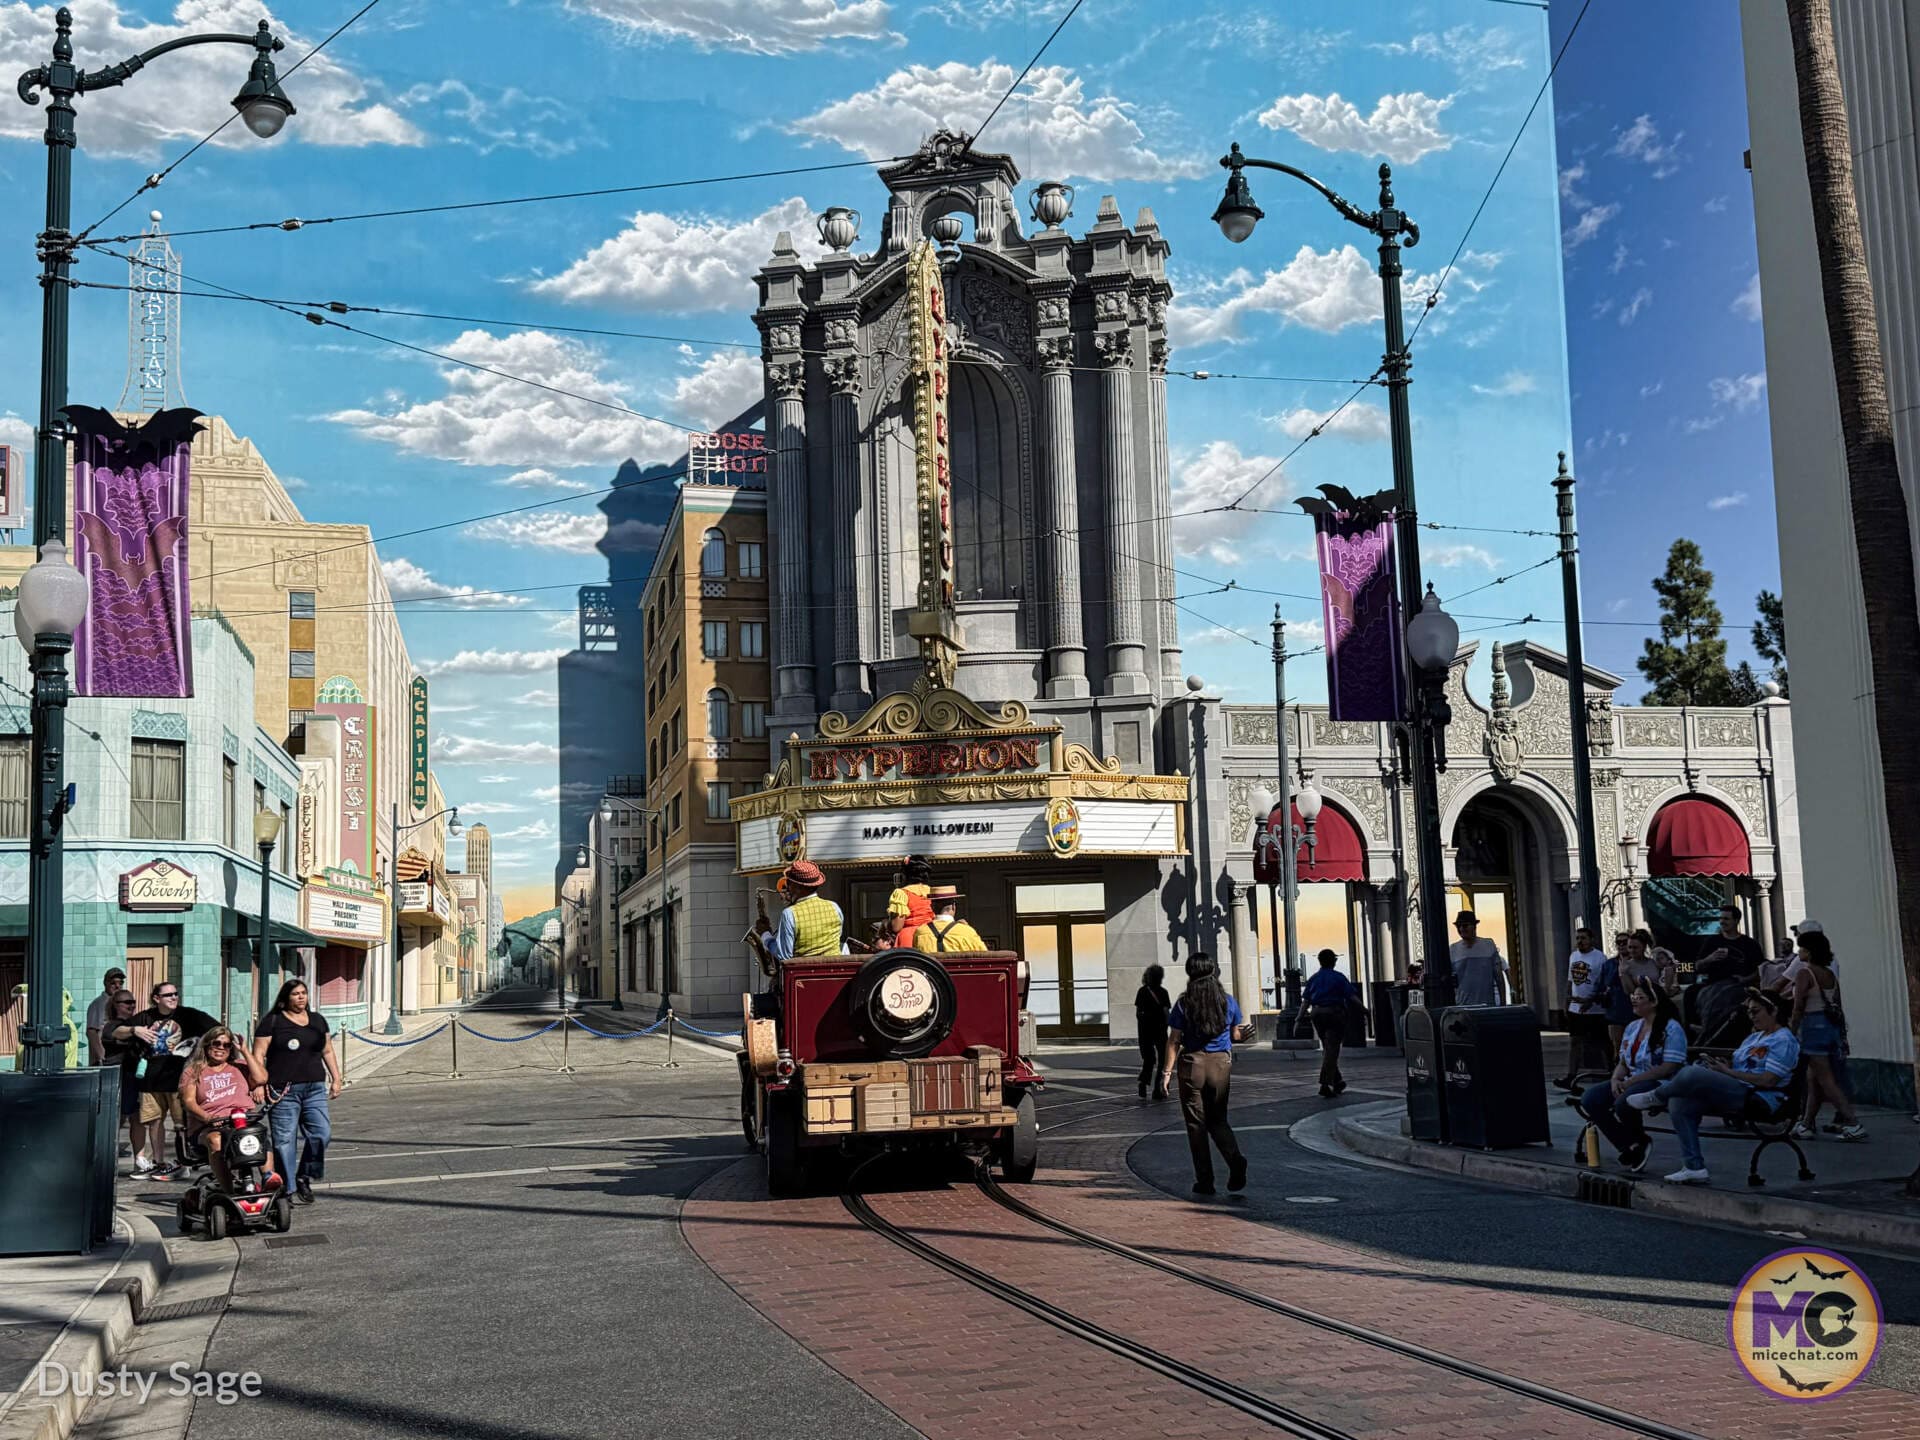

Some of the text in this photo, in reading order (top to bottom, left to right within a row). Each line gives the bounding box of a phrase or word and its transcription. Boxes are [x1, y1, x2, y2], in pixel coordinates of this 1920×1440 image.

[144, 270, 164, 389] CAPITAN
[414, 700, 426, 796] CAPITAN
[809, 738, 1041, 780] HYPERION
[343, 716, 366, 832] CREST
[301, 795, 312, 875] BEVERLY
[863, 822, 994, 840] HAPPY HALLOWEEN!
[131, 877, 193, 901] Beverly
[332, 900, 362, 912] WALT DISNEY
[334, 910, 358, 920] PRESENTS
[898, 973, 914, 992] 5
[889, 992, 924, 1009] Dime
